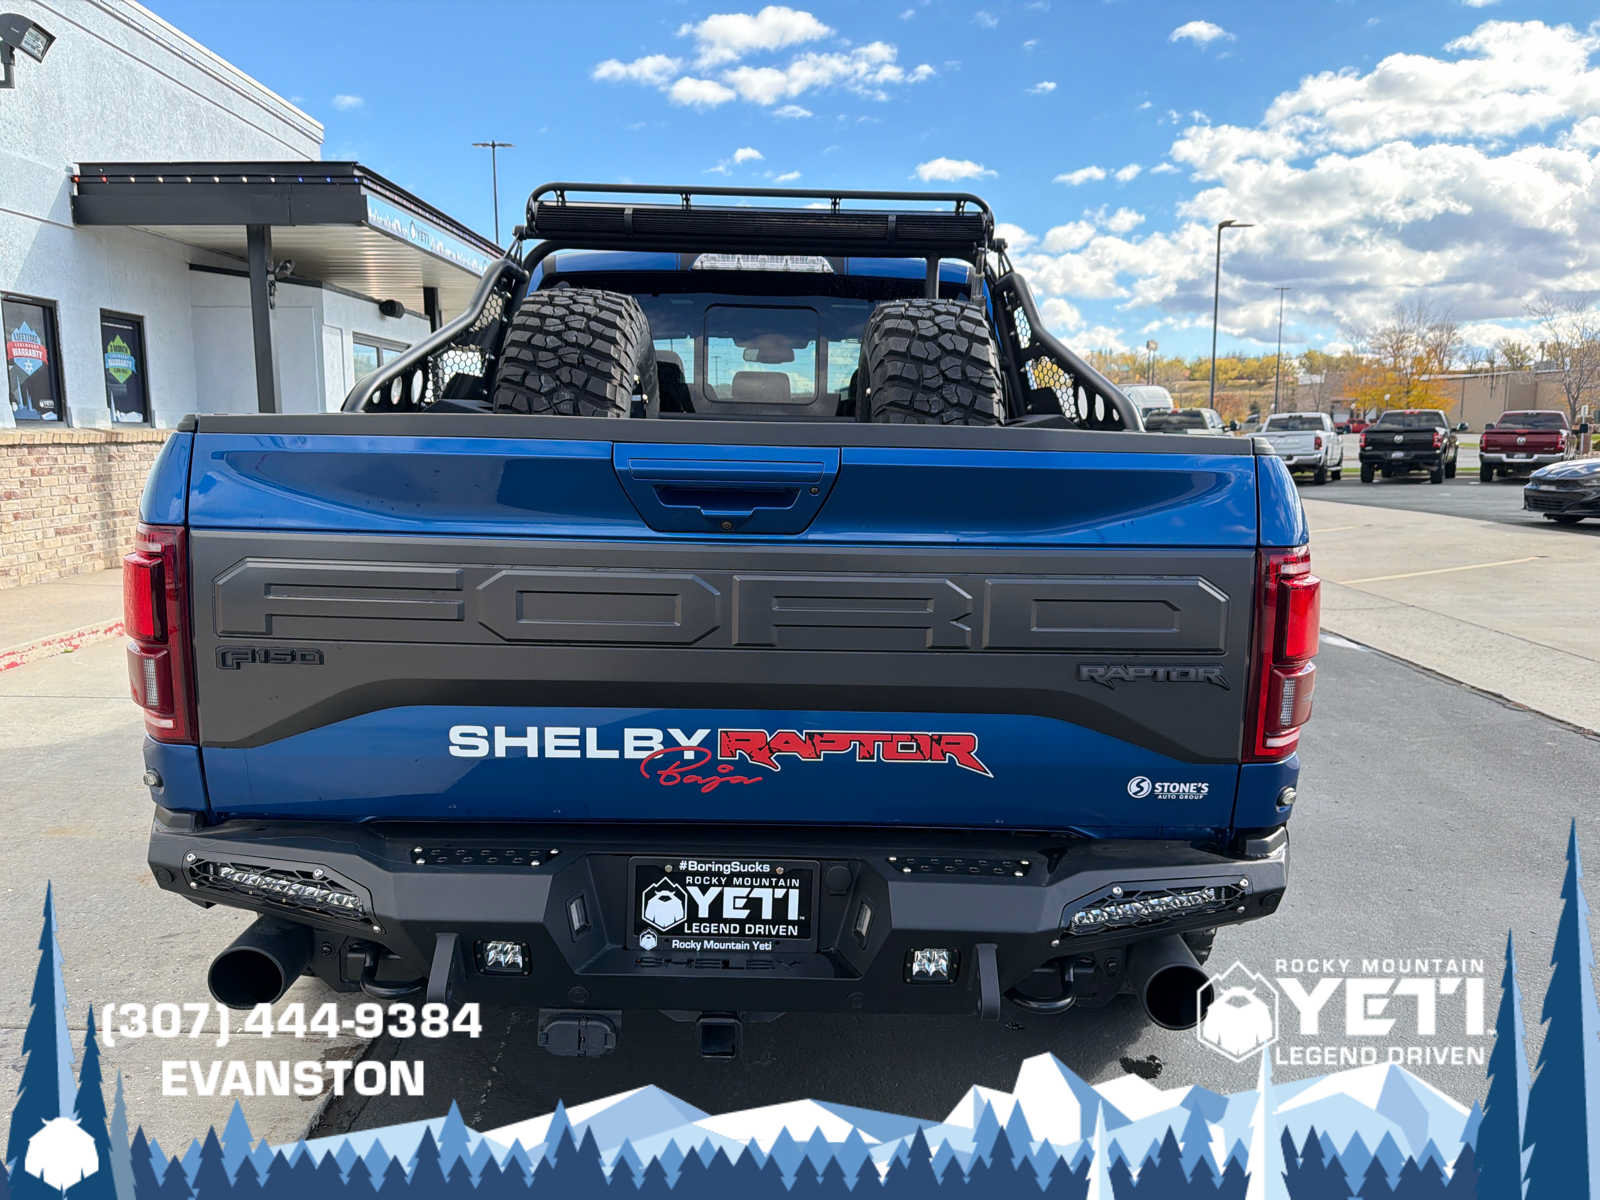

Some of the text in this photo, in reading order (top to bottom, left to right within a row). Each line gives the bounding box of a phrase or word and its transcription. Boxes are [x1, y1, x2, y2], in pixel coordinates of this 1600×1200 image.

[12, 347, 43, 358] WARRANTY
[213, 557, 1229, 652] FORD
[1077, 664, 1230, 690] RAPTOR
[448, 725, 995, 778] SHELBY RAPTOR
[641, 746, 763, 793] Baja
[1154, 782, 1209, 793] STONE'S
[679, 860, 771, 874] #BoringSucks
[686, 876, 800, 887] ROCKY MOUNTAIN
[686, 886, 800, 921] YETI
[684, 923, 798, 936] LEGEND DRIVEN
[672, 939, 772, 951] Rocky Mountain Yeti
